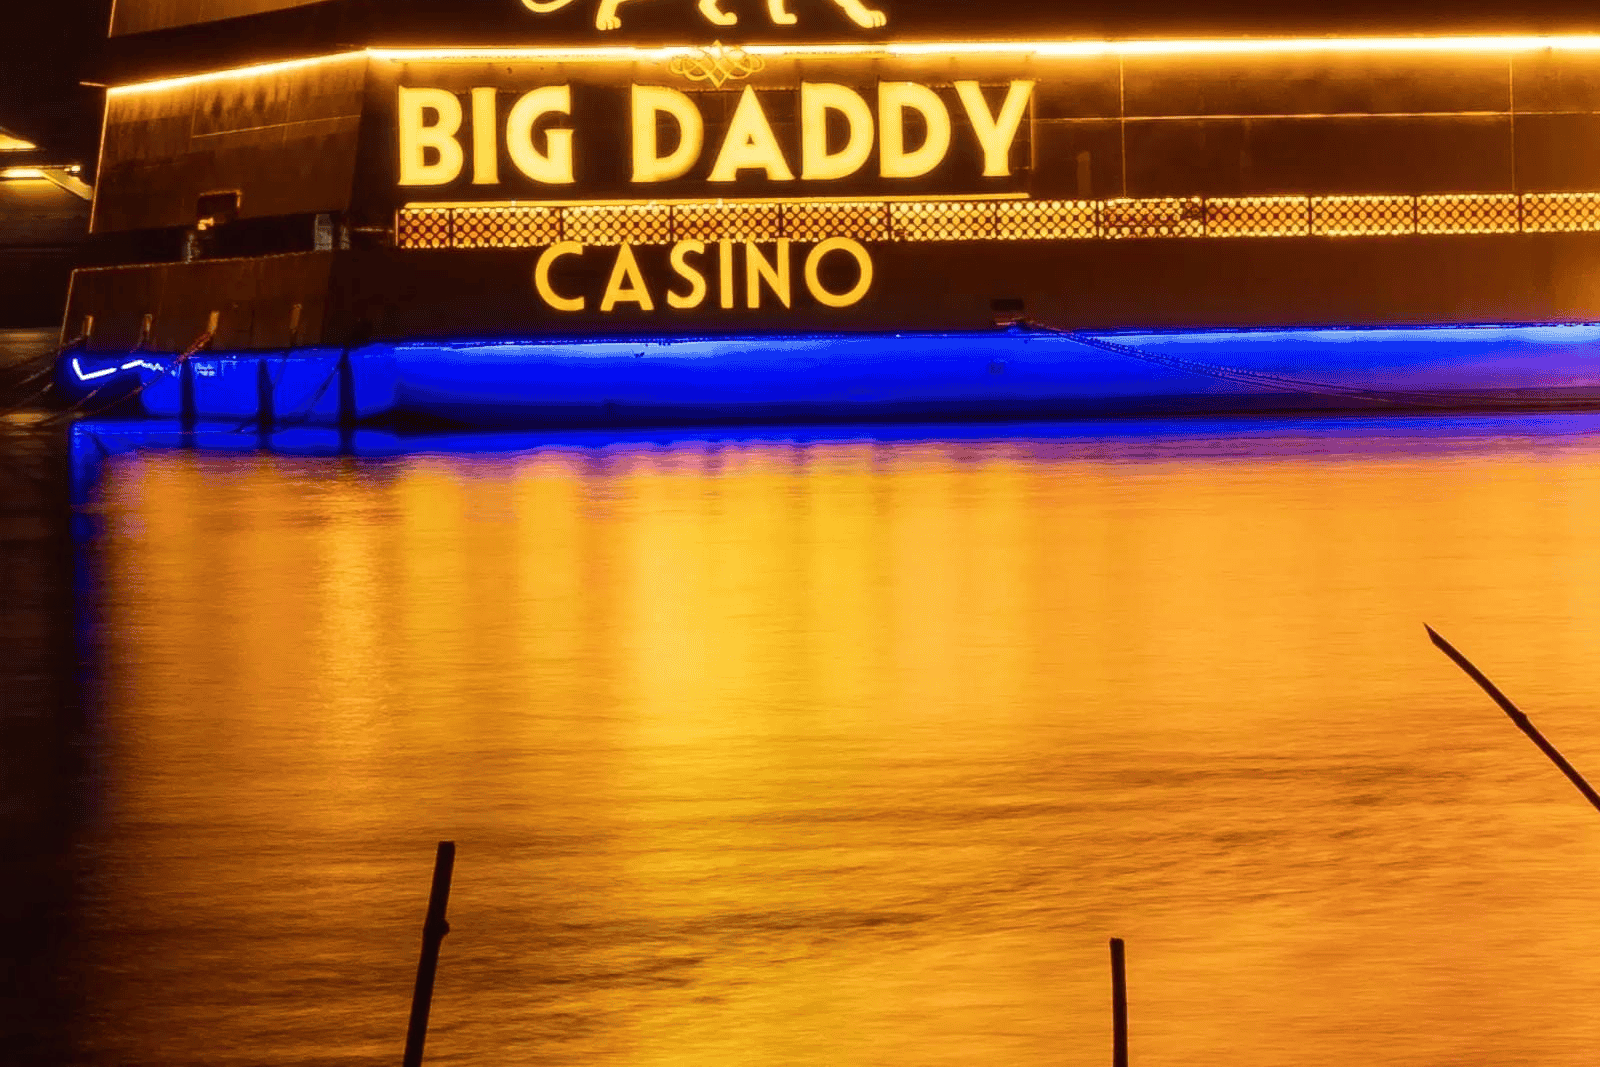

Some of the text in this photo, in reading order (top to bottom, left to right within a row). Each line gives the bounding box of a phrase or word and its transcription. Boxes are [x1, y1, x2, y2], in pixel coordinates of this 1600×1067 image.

[398, 79, 1037, 186] BIG DADDY
[534, 236, 874, 312] CASINO
